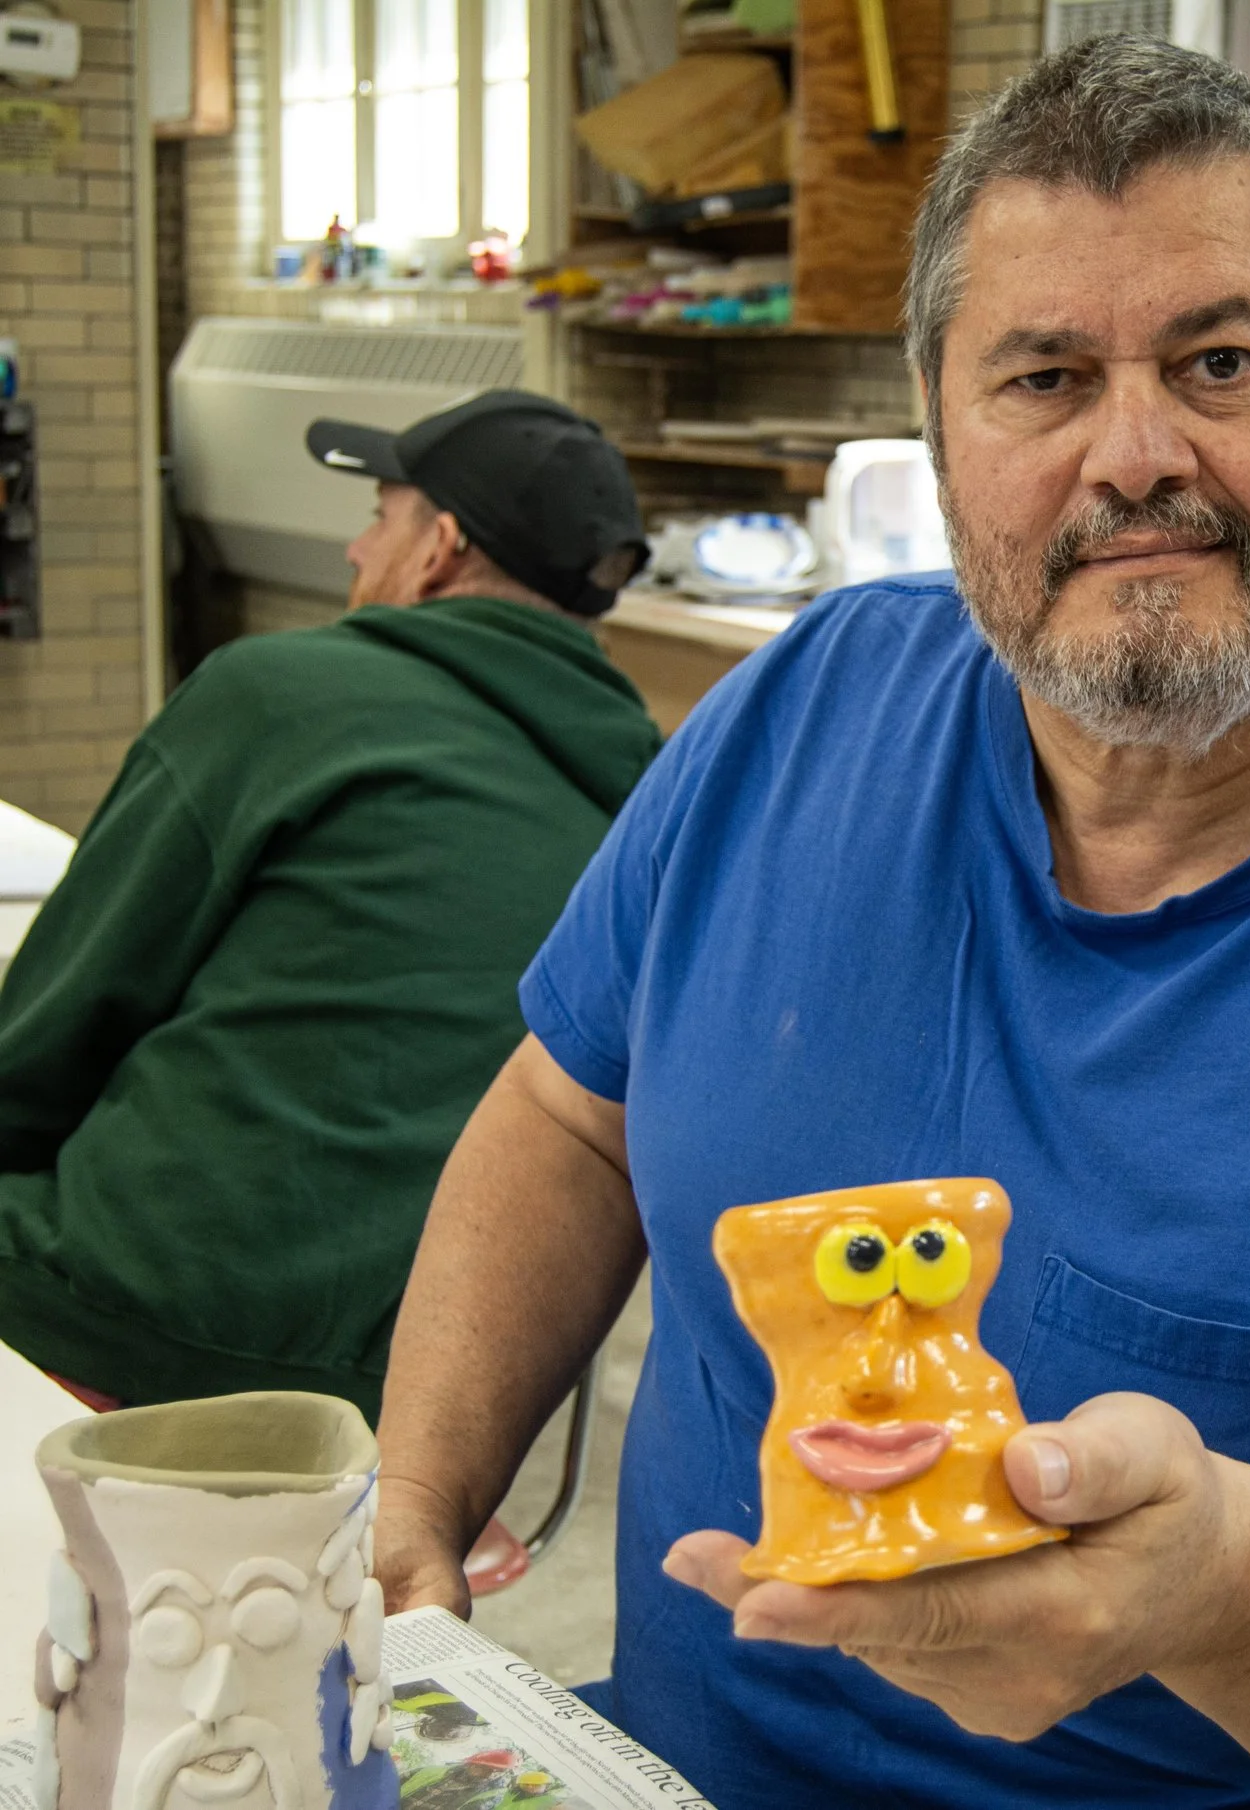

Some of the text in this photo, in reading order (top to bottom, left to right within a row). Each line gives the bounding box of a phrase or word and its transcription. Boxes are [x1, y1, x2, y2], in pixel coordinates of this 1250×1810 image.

[505, 1662, 592, 1720] Cooling
[580, 1722, 627, 1743] off
[610, 1744, 645, 1761] in
[636, 1762, 684, 1793] the
